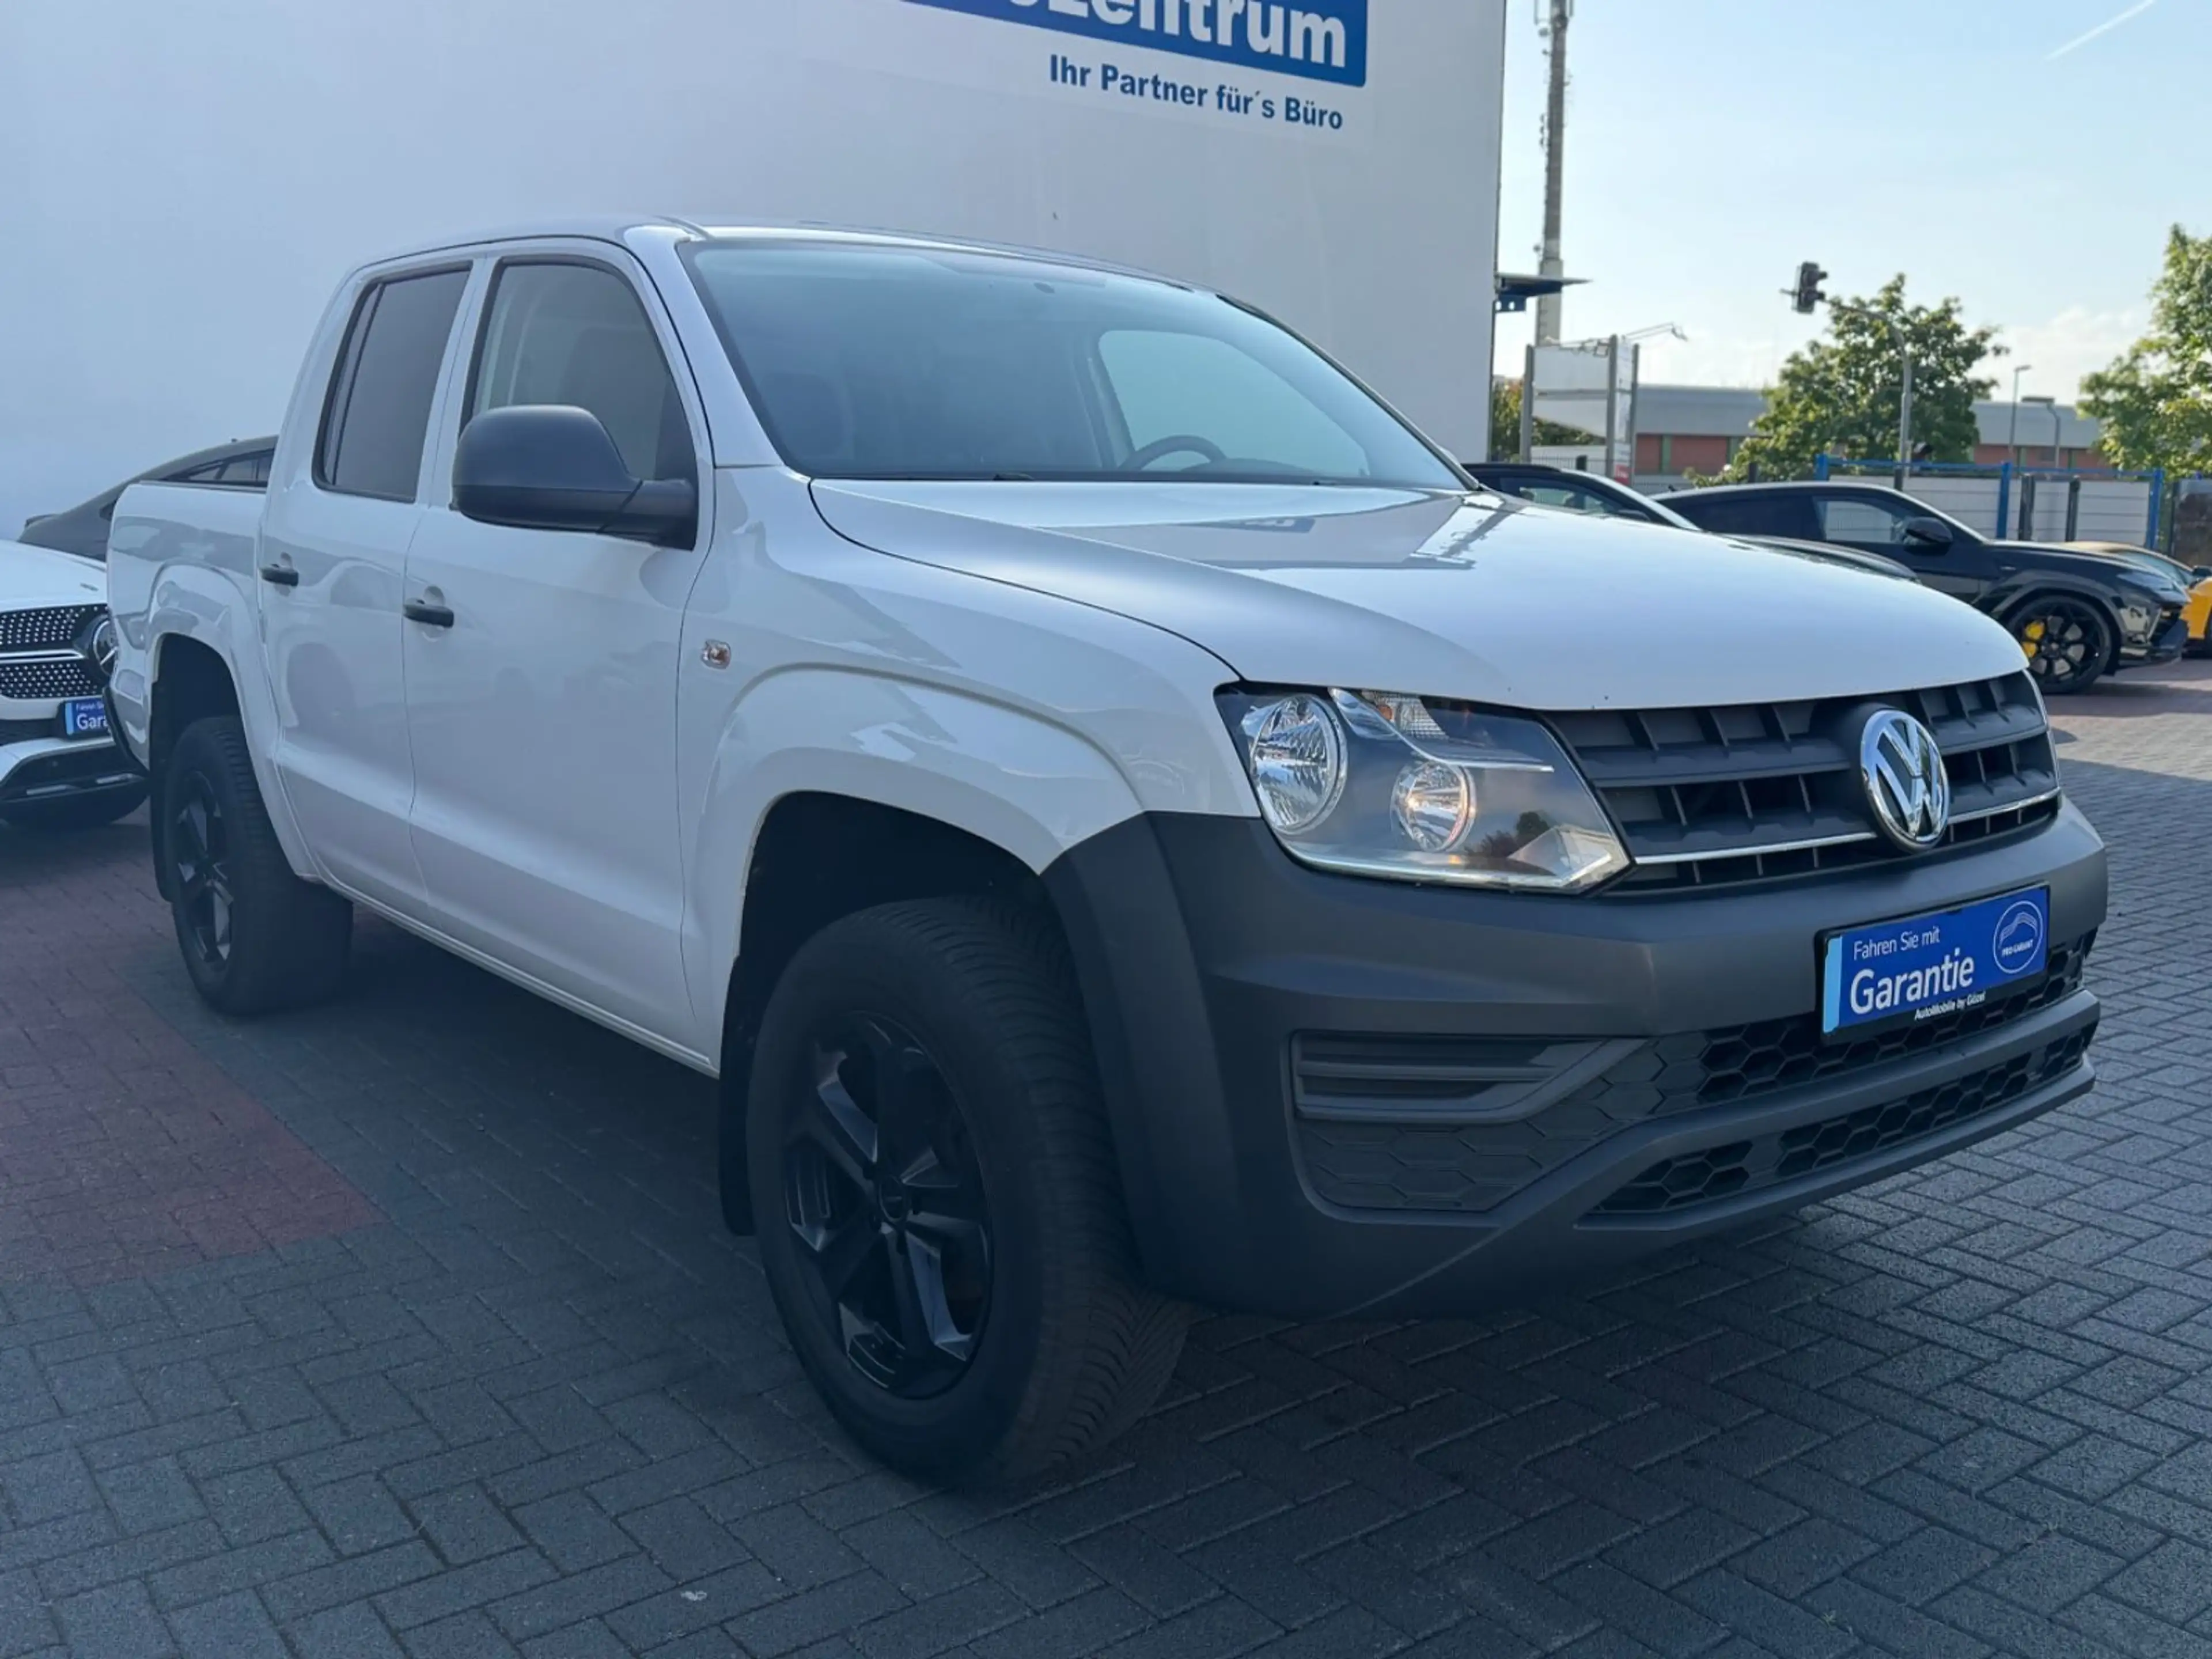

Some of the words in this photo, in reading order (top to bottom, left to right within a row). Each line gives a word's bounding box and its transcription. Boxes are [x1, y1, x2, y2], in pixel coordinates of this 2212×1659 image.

[1050, 54, 1091, 87] Ihr
[1101, 63, 1208, 107] Partner
[1285, 96, 1343, 130] Büro
[1853, 938, 1897, 961] Fahren
[1900, 930, 1919, 950] Sie
[1921, 925, 1940, 946] mit
[1850, 946, 1975, 1015] Garantie
